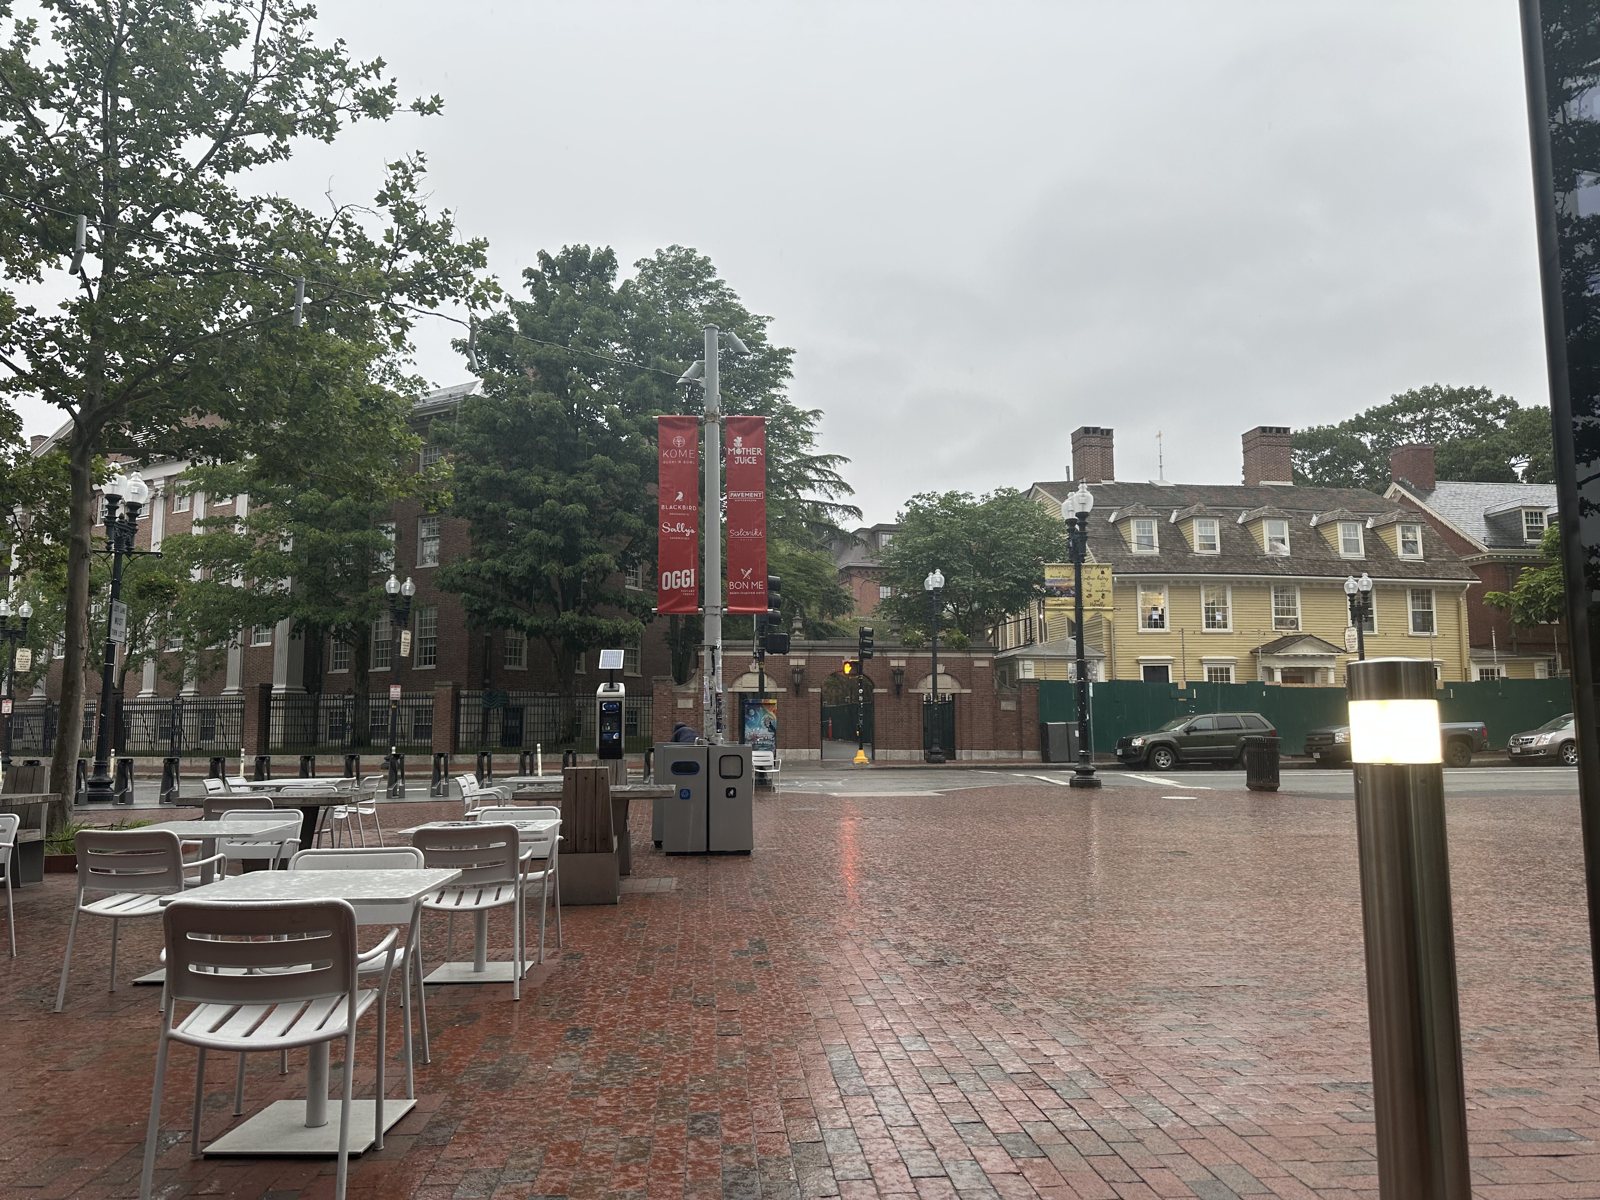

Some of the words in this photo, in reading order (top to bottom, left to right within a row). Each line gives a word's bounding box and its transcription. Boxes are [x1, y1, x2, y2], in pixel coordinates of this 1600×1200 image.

[662, 449, 695, 459] KOME
[727, 447, 763, 456] MOTHER
[661, 504, 697, 512] BLACKBIRD
[661, 521, 696, 537] Sally's
[729, 528, 763, 537] Saloniki
[661, 568, 695, 591] OGGI
[729, 581, 749, 590] BON
[751, 581, 764, 590] ME
